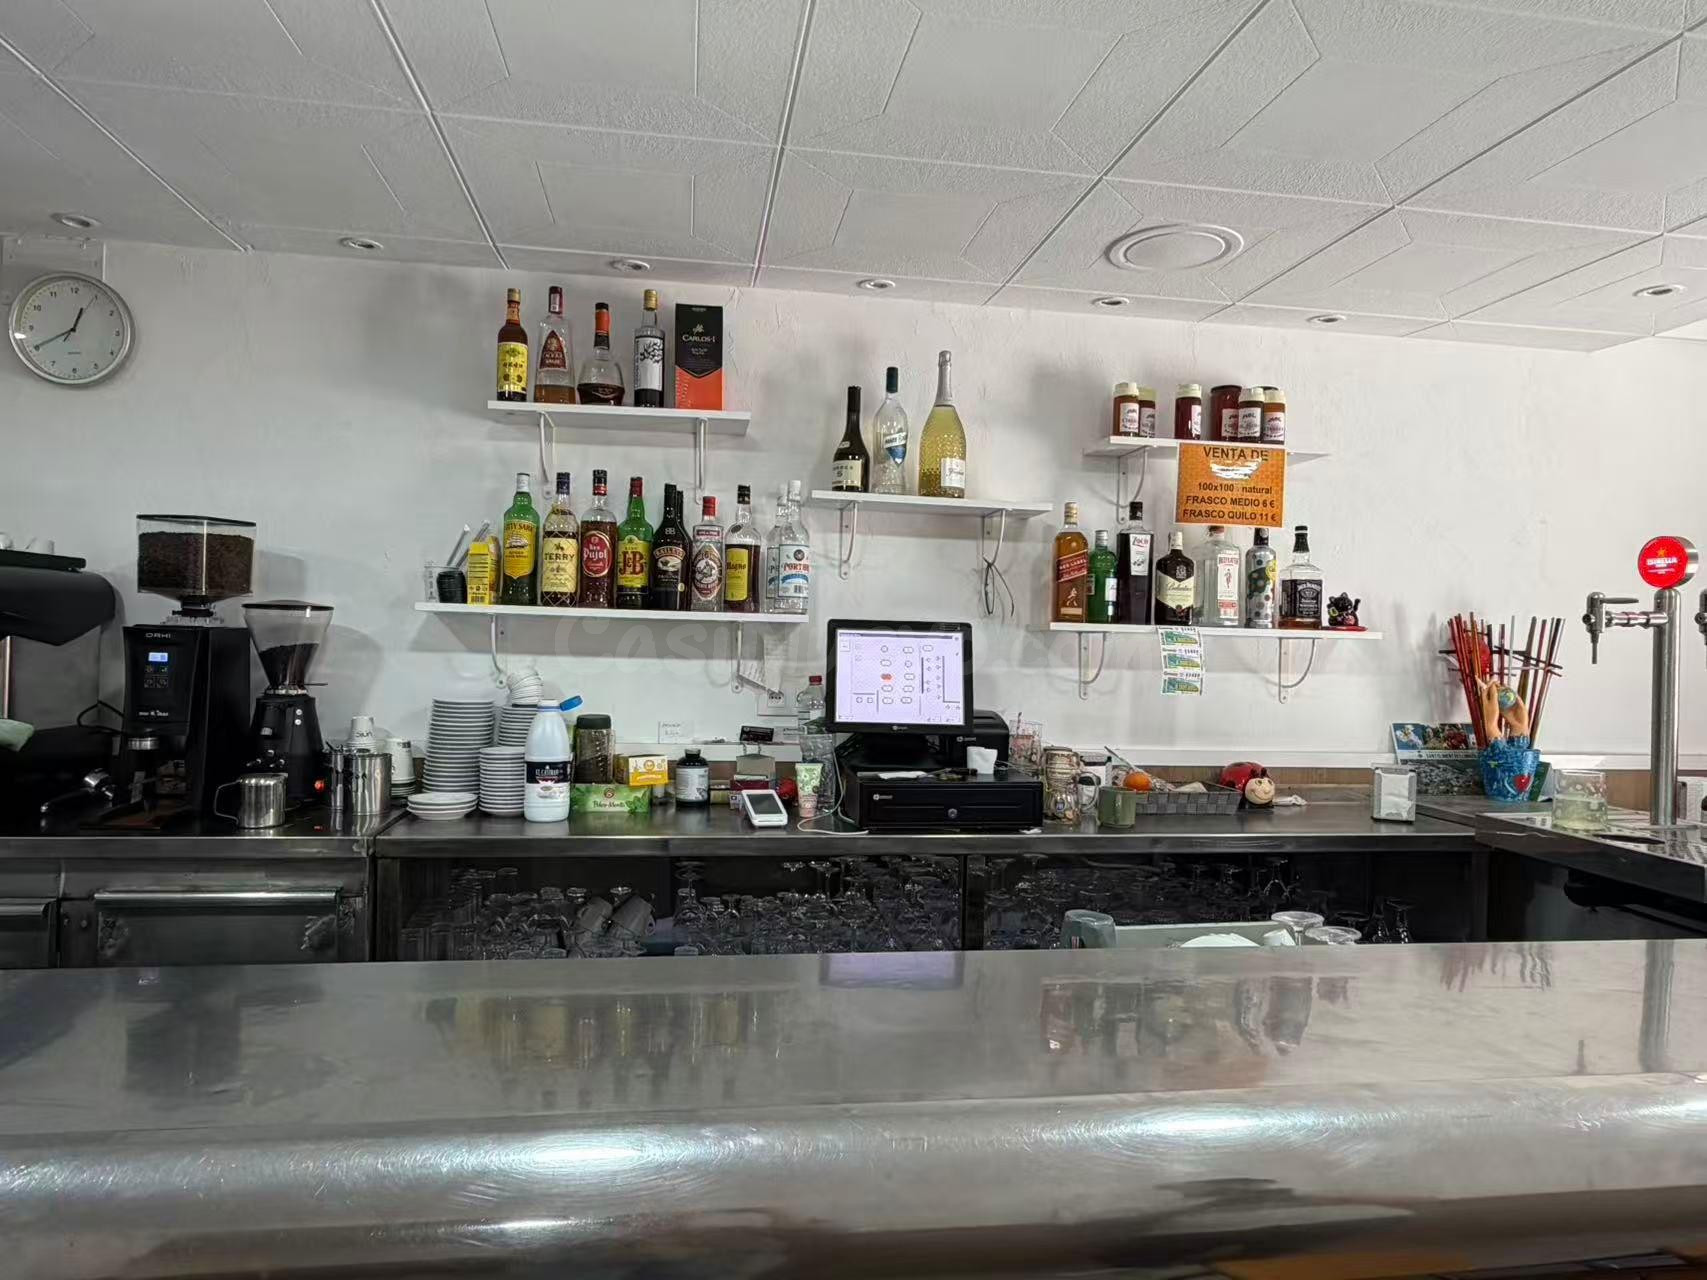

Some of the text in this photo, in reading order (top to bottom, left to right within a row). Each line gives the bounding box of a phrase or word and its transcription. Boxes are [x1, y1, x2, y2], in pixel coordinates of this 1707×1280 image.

[1203, 446, 1269, 462] VENTA DE
[1198, 482, 1273, 495] 100x100 natural
[1185, 495, 1275, 509] FRASCO MEDIO 6 €
[1183, 509, 1277, 522] FRASCO QUILO 11 €
[544, 552, 575, 561] TERRY
[583, 548, 607, 561] Pujol
[619, 551, 645, 576] J&B
